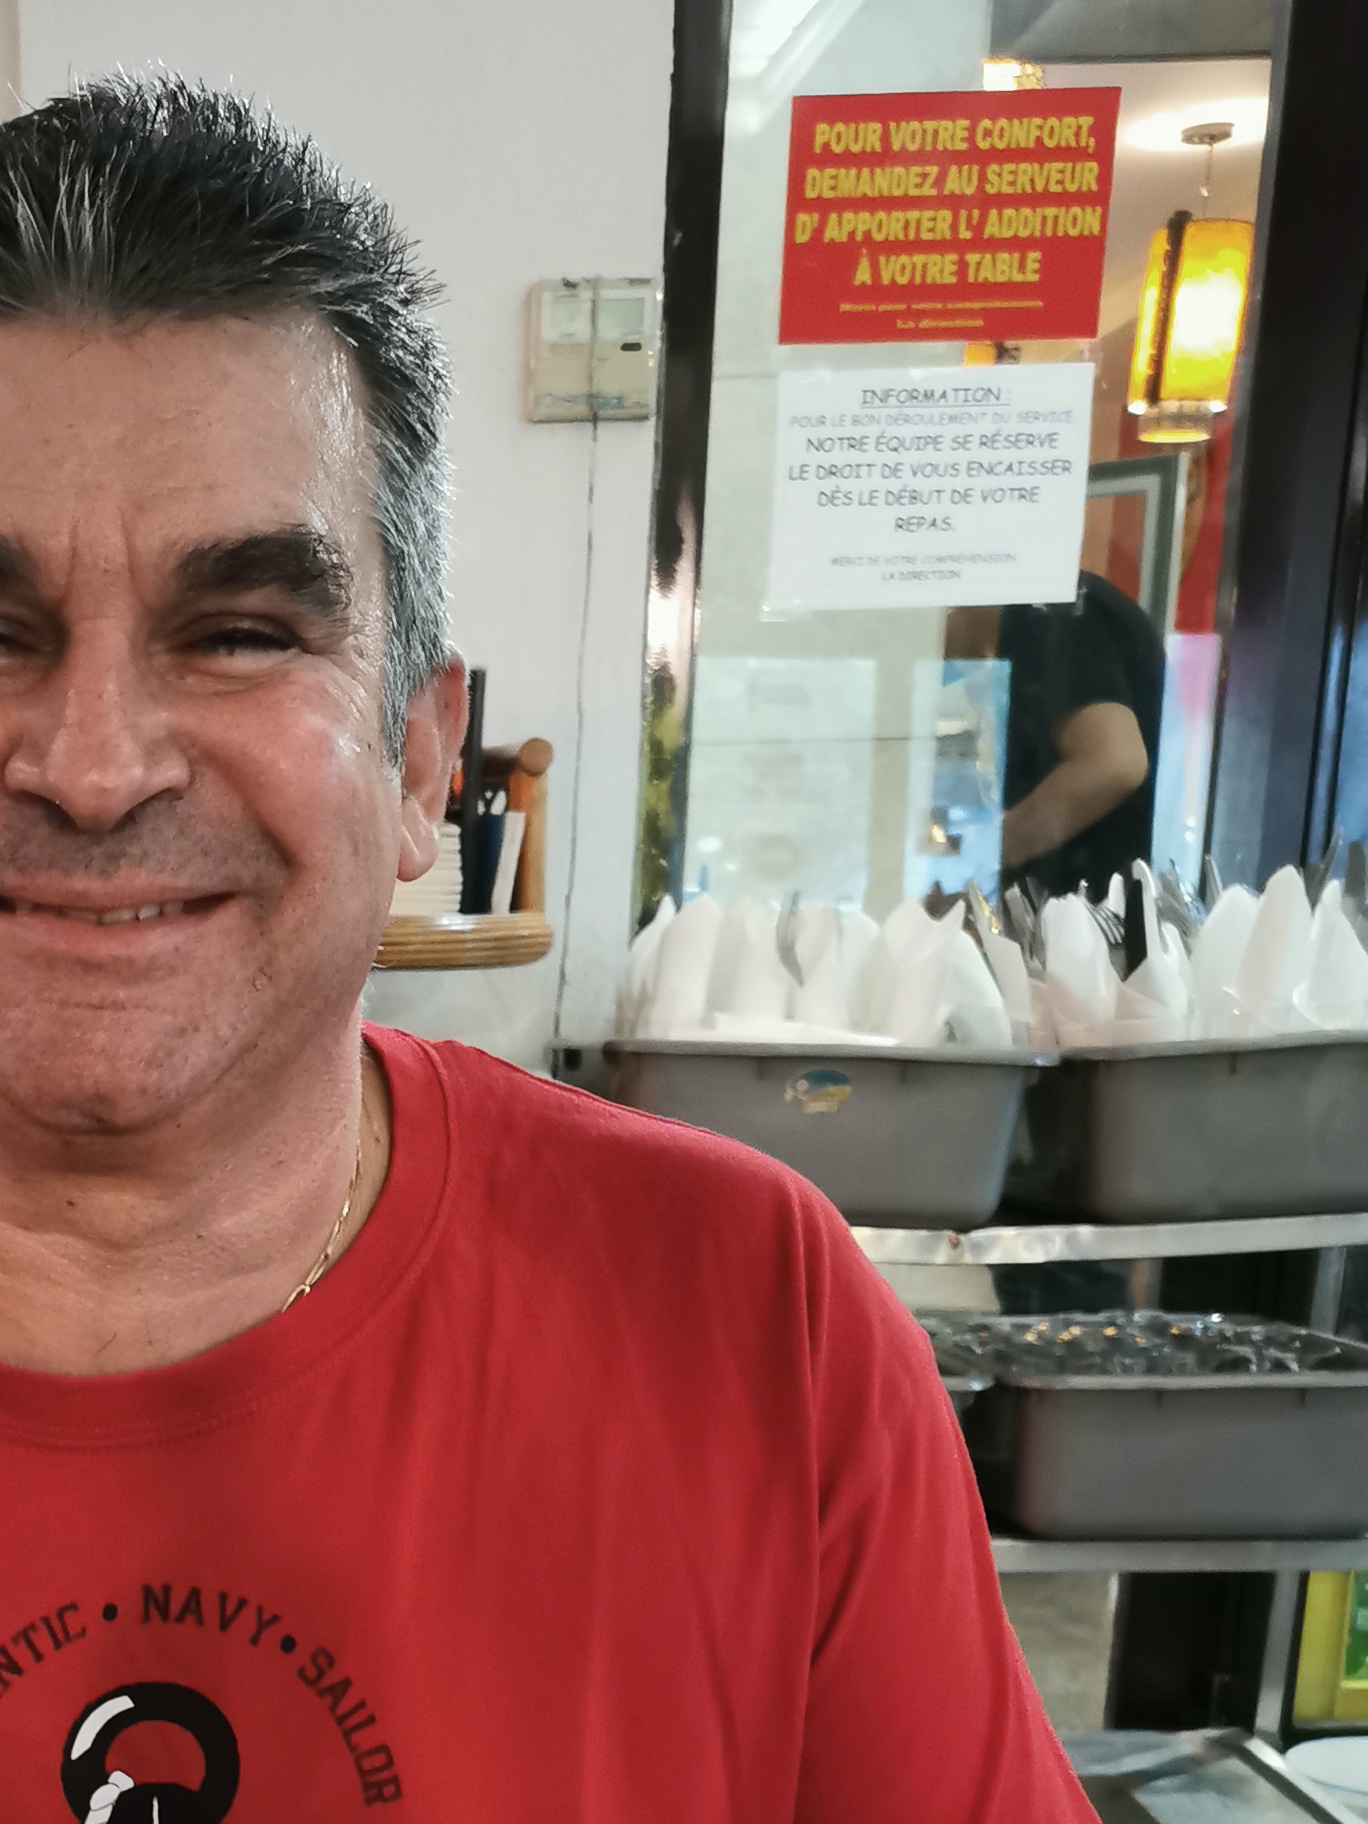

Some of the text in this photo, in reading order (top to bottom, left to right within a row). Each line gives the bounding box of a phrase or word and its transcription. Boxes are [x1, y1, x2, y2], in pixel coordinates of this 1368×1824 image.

[813, 117, 1096, 153] POUR VOTRE CONFORT,
[805, 162, 1098, 199] DEMANDEZ AU SERVEUR
[824, 210, 952, 243] APPORTER
[983, 206, 1102, 239] ADDITION
[879, 254, 959, 286] VOTRE
[965, 252, 1042, 283] TABLE
[805, 428, 1059, 454] NOTRE ÉQUIPE SE RÉSERVE
[788, 458, 1072, 481] LE DROIT DE VOUS ENCAISSER
[858, 489, 880, 507] LE
[884, 484, 945, 506] DÉBUT
[950, 487, 974, 505] DE
[980, 485, 1040, 504] VOTRE
[140, 1584, 281, 1647] NAVY
[296, 1647, 402, 1807] SAILOR
